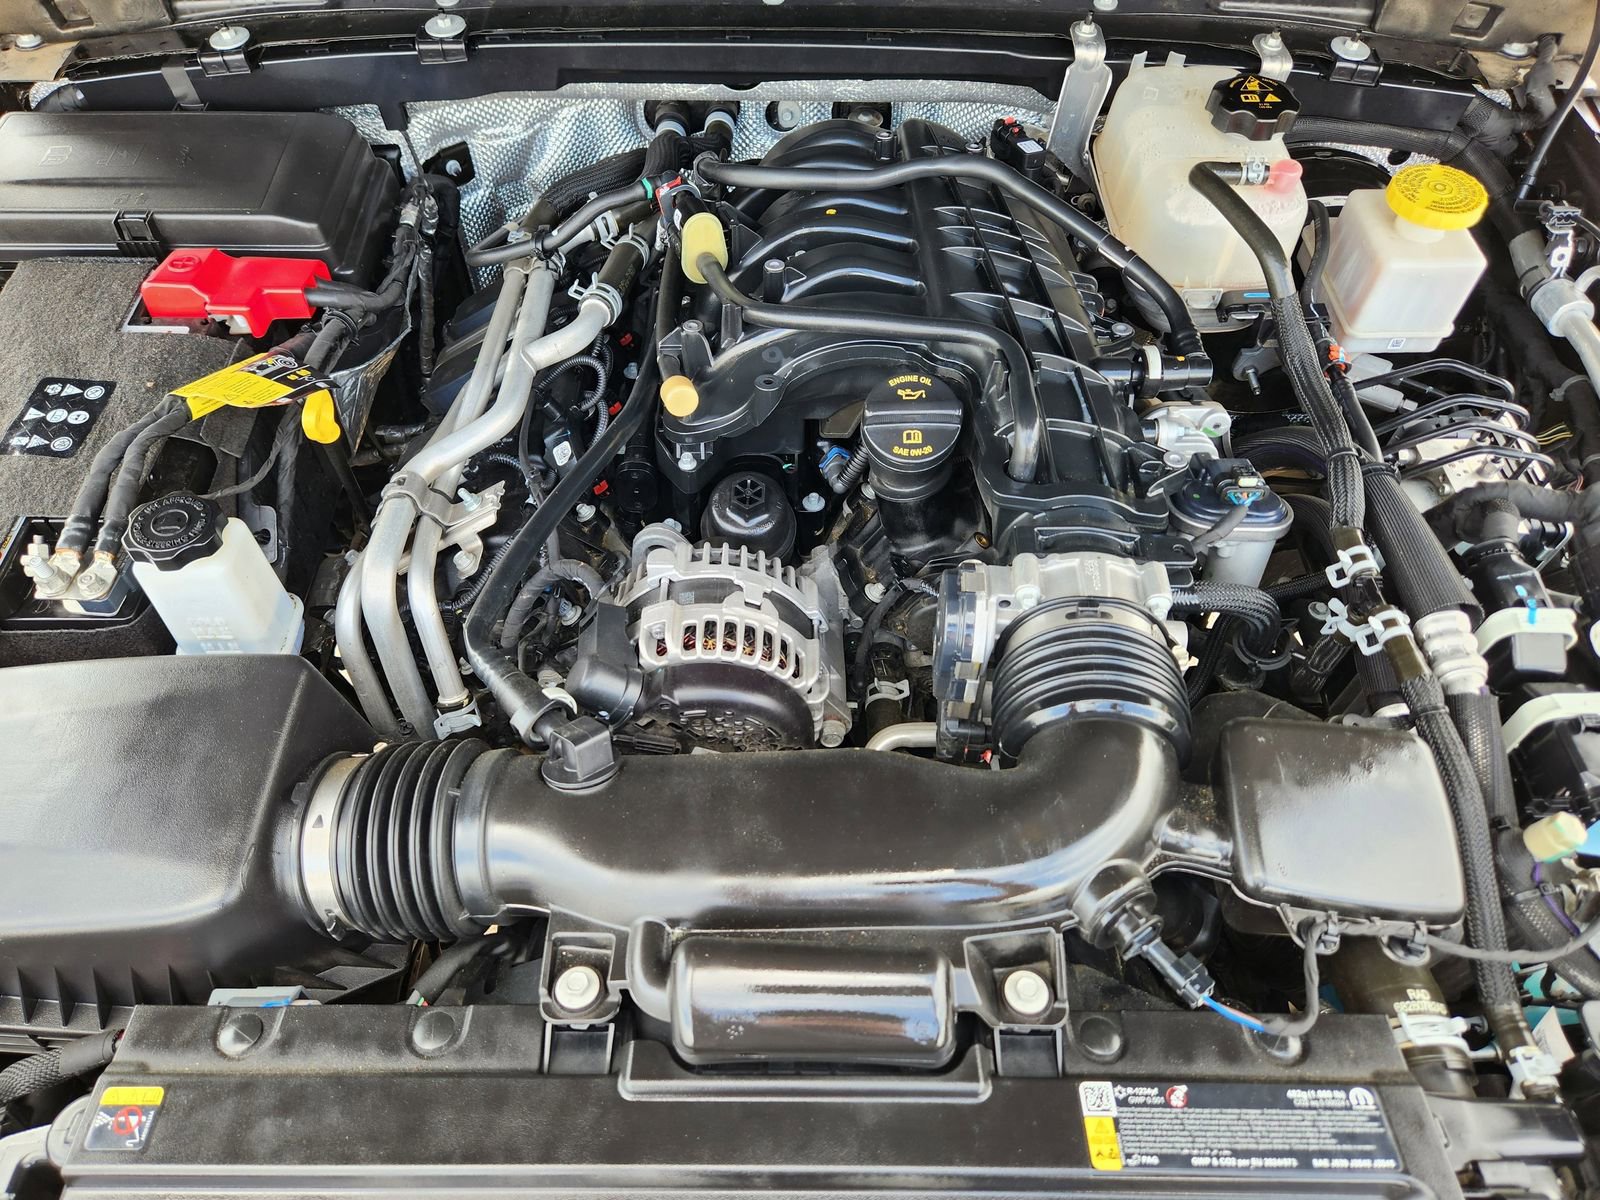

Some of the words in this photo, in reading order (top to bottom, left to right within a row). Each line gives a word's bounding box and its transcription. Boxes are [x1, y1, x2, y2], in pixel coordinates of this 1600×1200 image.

[888, 375, 919, 387] ENGINE
[919, 376, 932, 386] OIL
[892, 445, 909, 456] SAE
[910, 445, 933, 456] 0W-20
[1405, 988, 1431, 1001] RAD
